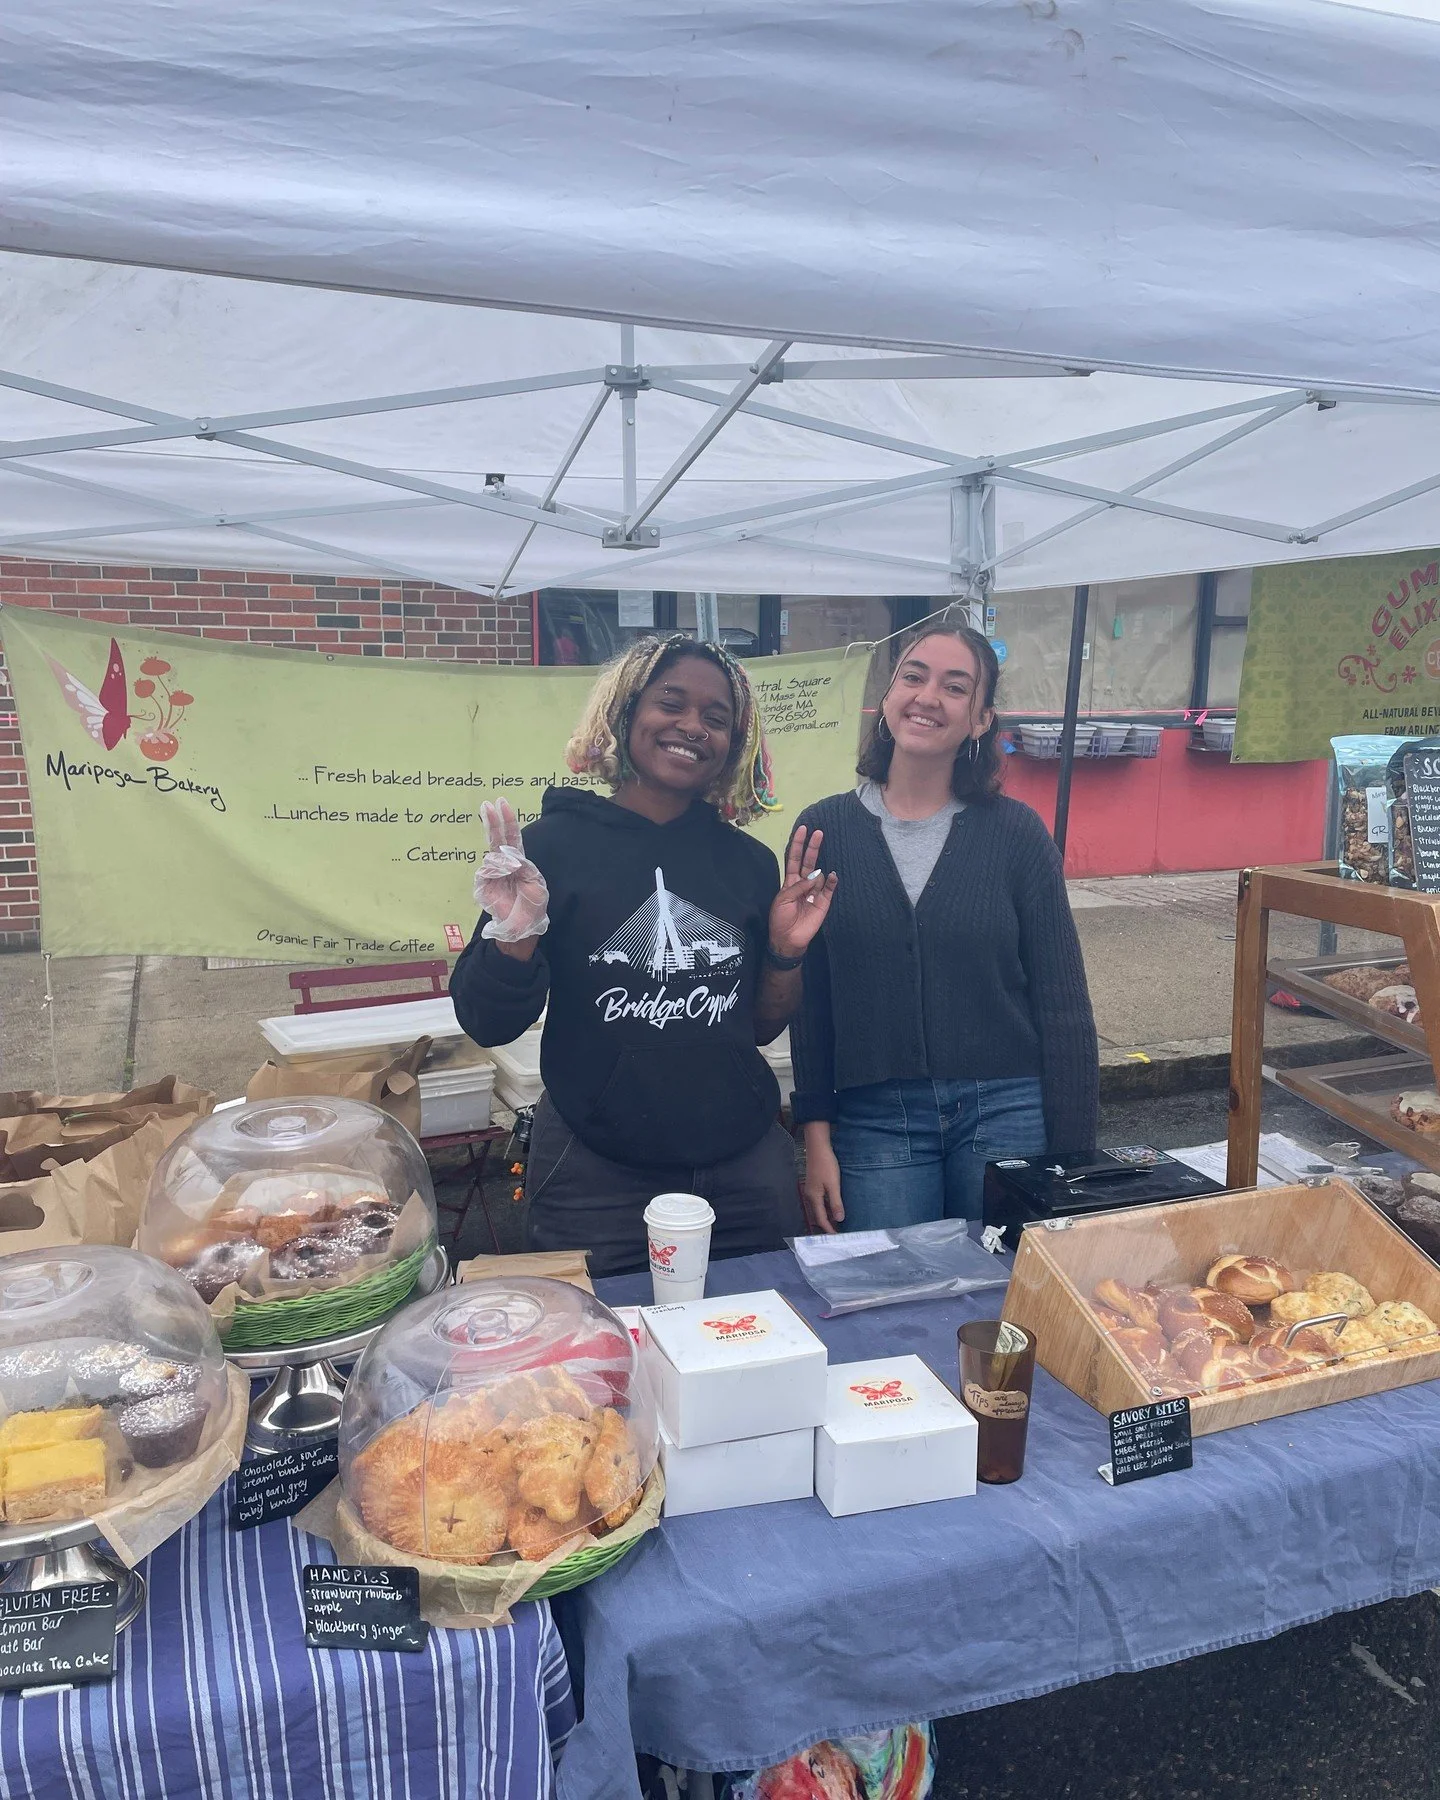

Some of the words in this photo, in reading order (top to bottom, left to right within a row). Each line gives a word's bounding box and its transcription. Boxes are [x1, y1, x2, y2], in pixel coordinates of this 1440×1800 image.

[1388, 597, 1440, 651] ELIX
[787, 676, 831, 691] Square
[769, 692, 795, 704] Mass
[798, 689, 818, 699] Ave
[796, 700, 813, 711] MA
[1363, 707, 1419, 720] ALL-NATURAL
[46, 750, 148, 791] Mariposa
[146, 766, 227, 812] Bakery
[314, 765, 367, 785] Fresh
[372, 769, 422, 786] baked
[492, 773, 524, 789] pies
[530, 772, 556, 787] and
[355, 808, 399, 823] made
[404, 808, 424, 823] to
[429, 809, 472, 824] order
[406, 846, 477, 864] Catering
[256, 929, 309, 946] Organic
[313, 936, 340, 949] Fair
[344, 938, 385, 952] Trade
[389, 939, 435, 953] Coffee
[715, 1329, 767, 1341] MARIPOSA
[863, 1396, 914, 1408] MARIPOSA
[1113, 1407, 1151, 1428] SAVORY
[1155, 1399, 1186, 1417] BITES
[266, 1483, 285, 1498] earl
[288, 1478, 308, 1496] grey
[239, 1504, 264, 1521] baby
[61, 1585, 104, 1605] FREE
[365, 1588, 403, 1601] rhubarb
[314, 1601, 343, 1615] apple
[41, 1616, 64, 1631] Bar
[371, 1623, 406, 1641] ginger
[23, 1637, 44, 1652] Bar
[49, 1656, 71, 1671] Tea
[75, 1652, 109, 1668] Cake
